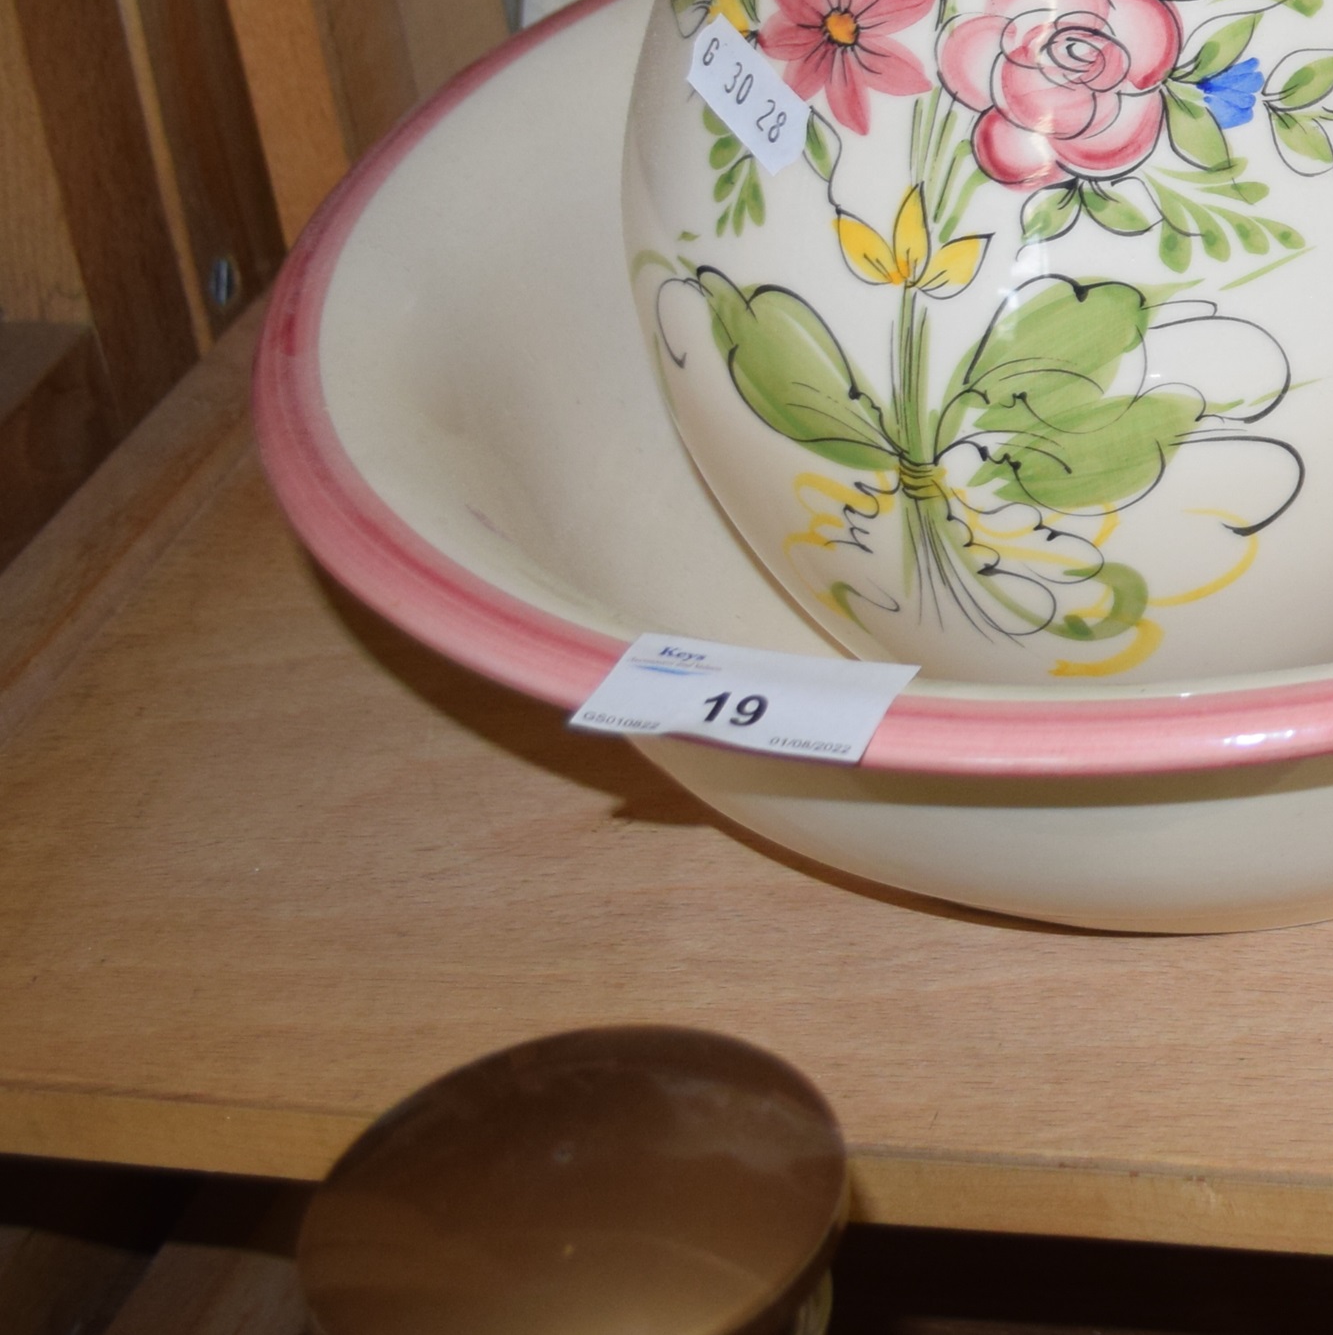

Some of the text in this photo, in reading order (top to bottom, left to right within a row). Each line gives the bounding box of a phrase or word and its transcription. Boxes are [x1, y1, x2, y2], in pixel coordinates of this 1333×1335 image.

[724, 62, 754, 105] 30
[756, 99, 787, 143] 28
[658, 646, 706, 662] Keys
[703, 691, 768, 727] 19
